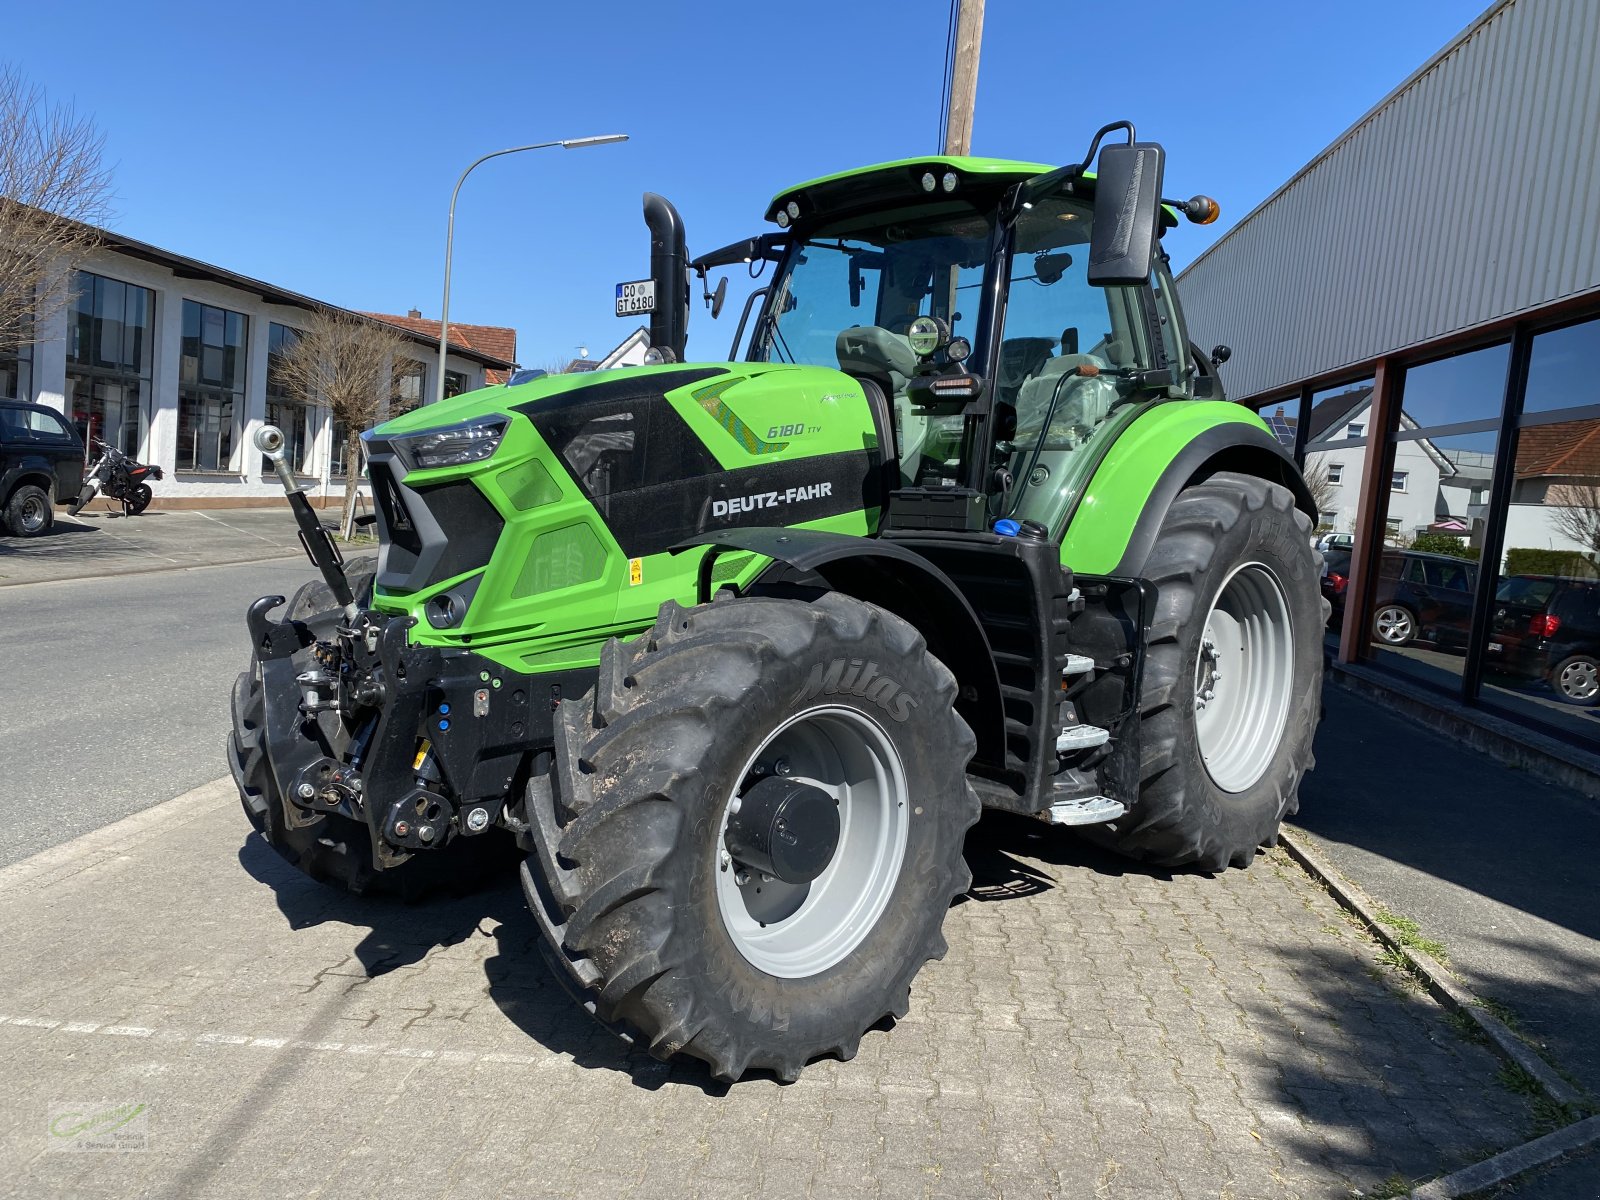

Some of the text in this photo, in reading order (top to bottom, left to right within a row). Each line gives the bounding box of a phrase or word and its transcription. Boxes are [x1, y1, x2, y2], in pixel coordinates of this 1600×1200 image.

[624, 285, 635, 297] CO
[618, 296, 653, 311] GT 6180
[767, 424, 821, 439] 6180 TTV
[712, 482, 832, 517] DEUTZ-FAHR
[790, 658, 919, 722] Mitas
